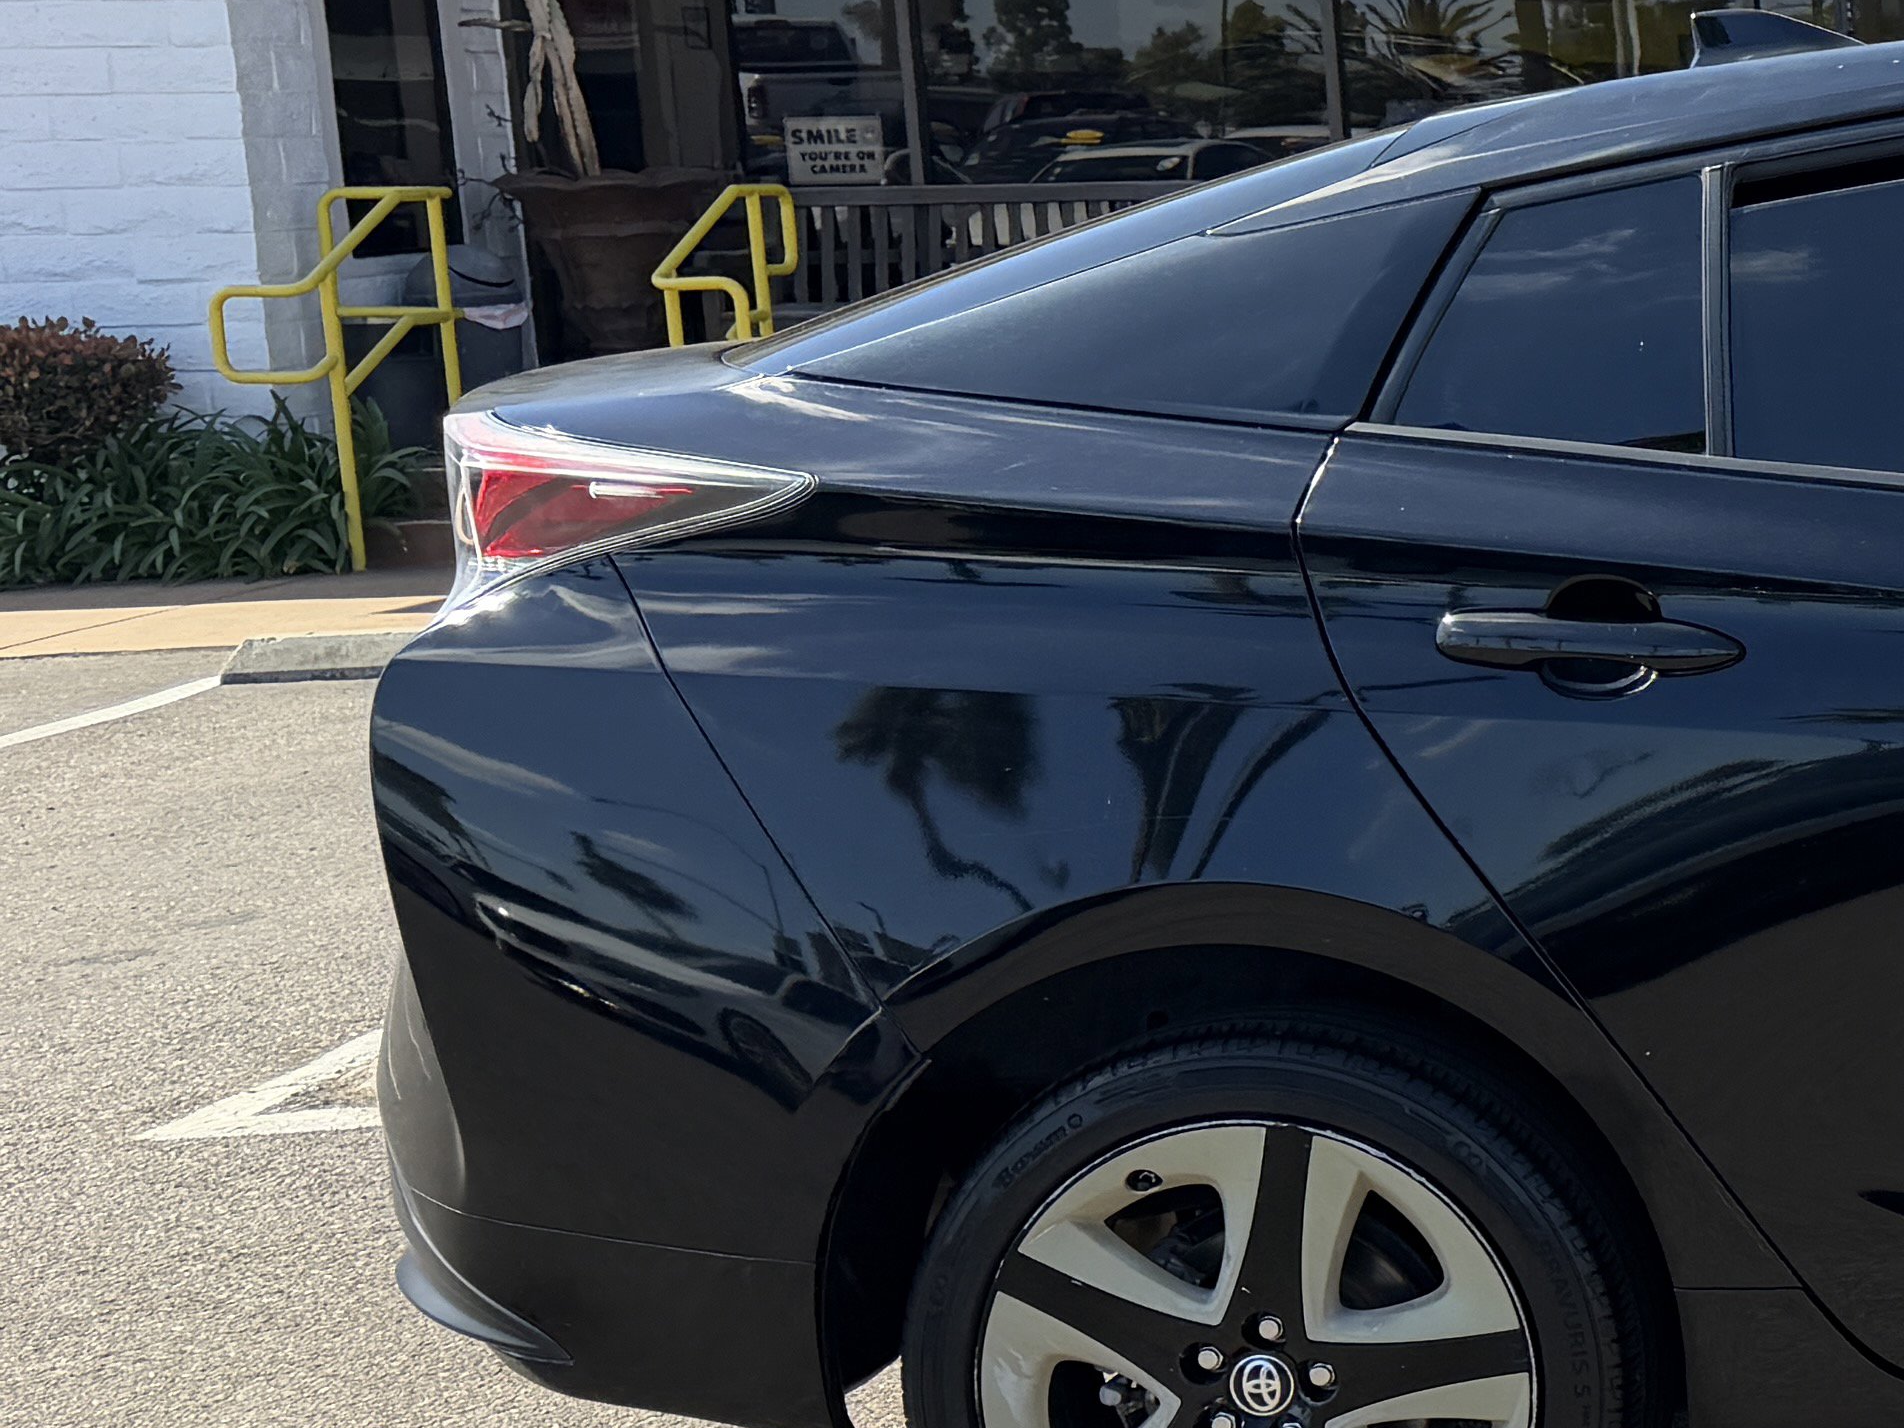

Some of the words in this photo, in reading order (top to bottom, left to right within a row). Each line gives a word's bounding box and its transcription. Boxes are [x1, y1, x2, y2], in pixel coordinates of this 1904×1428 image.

[790, 128, 858, 145] SMILE
[800, 150, 851, 162] YOU'RE
[856, 150, 876, 161] ON
[809, 163, 868, 175] CAMERA
